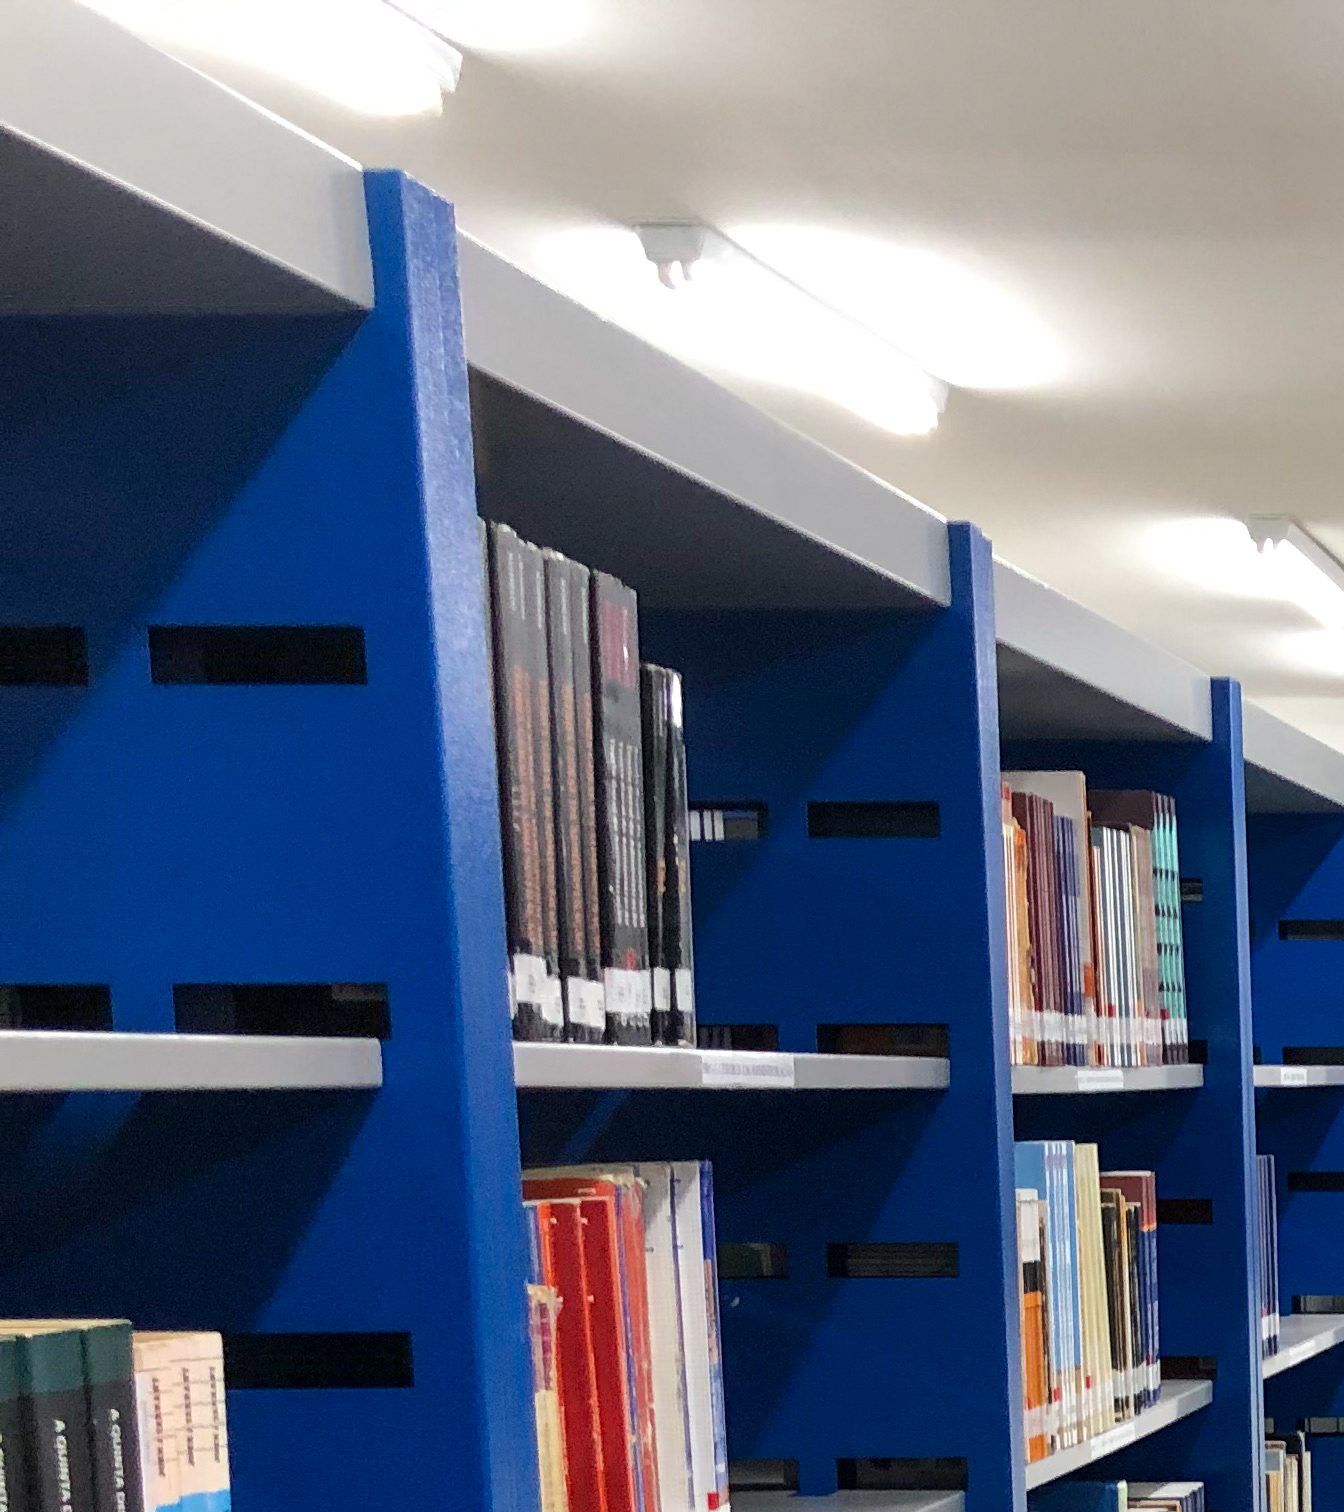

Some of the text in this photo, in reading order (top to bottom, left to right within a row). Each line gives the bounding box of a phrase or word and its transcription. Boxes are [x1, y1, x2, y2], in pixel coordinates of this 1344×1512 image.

[53, 1419, 66, 1433] A
[109, 1409, 120, 1421] A
[55, 1436, 71, 1501] QUINTA
[111, 1424, 125, 1487] QUINTA
